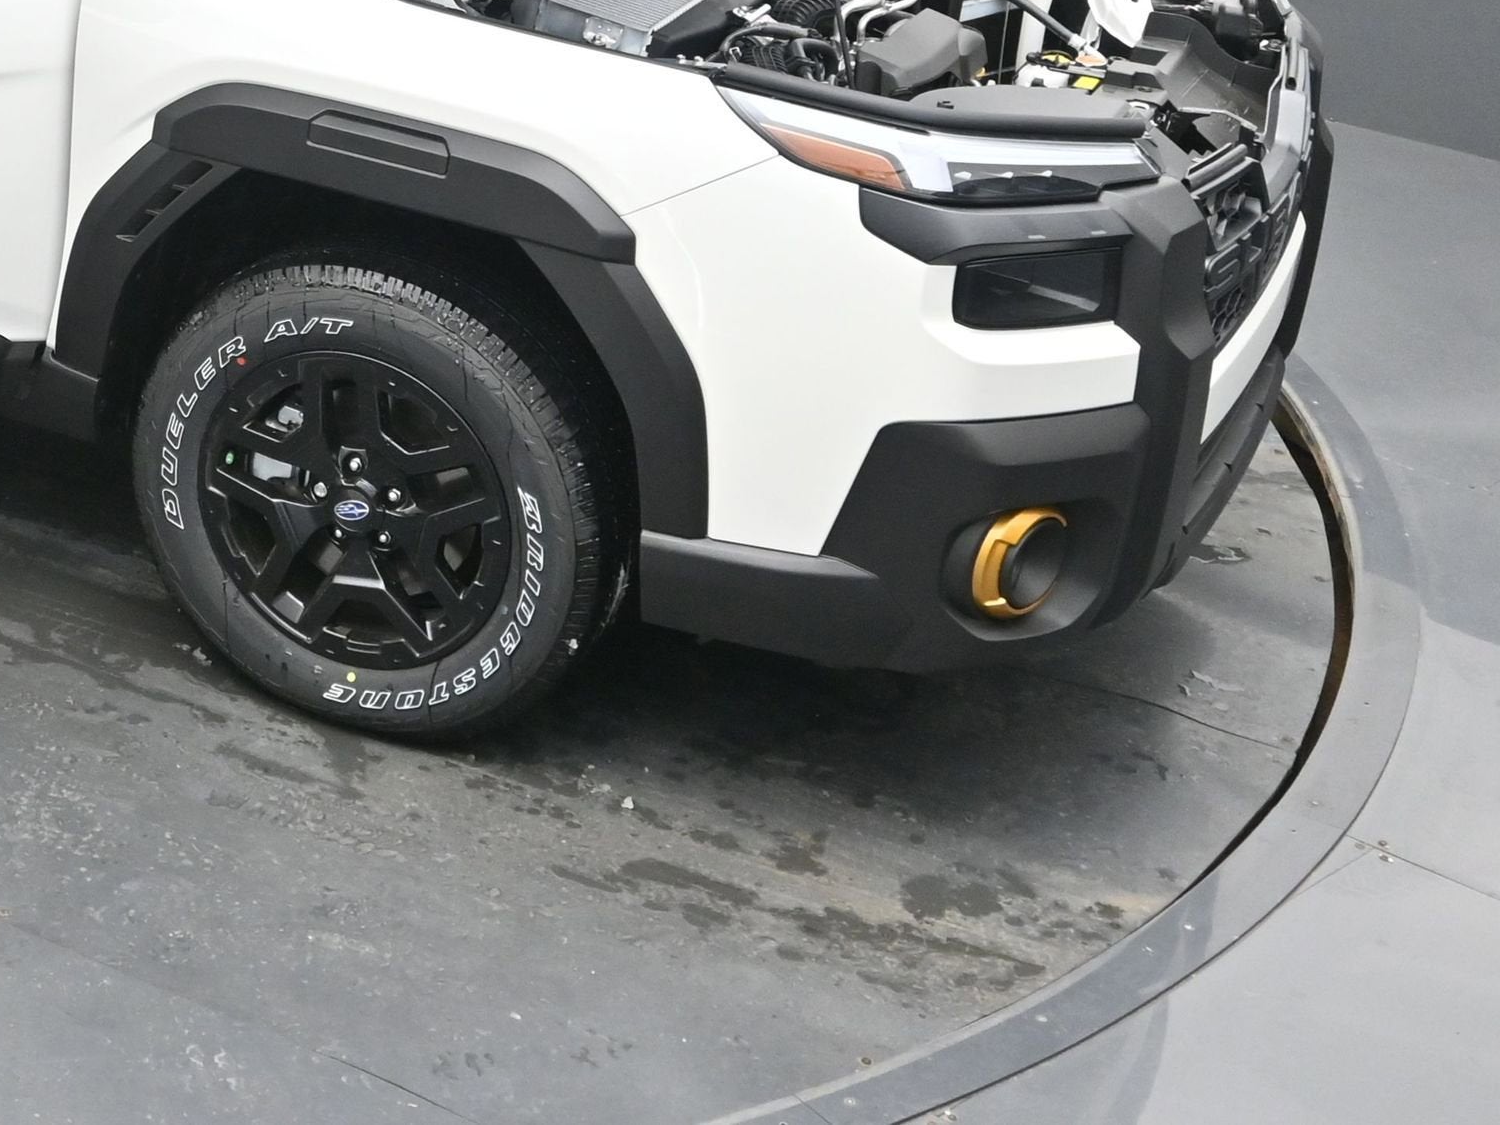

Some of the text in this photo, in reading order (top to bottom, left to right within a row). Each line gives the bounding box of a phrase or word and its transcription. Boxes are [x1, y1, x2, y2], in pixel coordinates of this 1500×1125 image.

[160, 316, 354, 530] DUELER A/T
[322, 485, 544, 710] BRIDGESTONE
